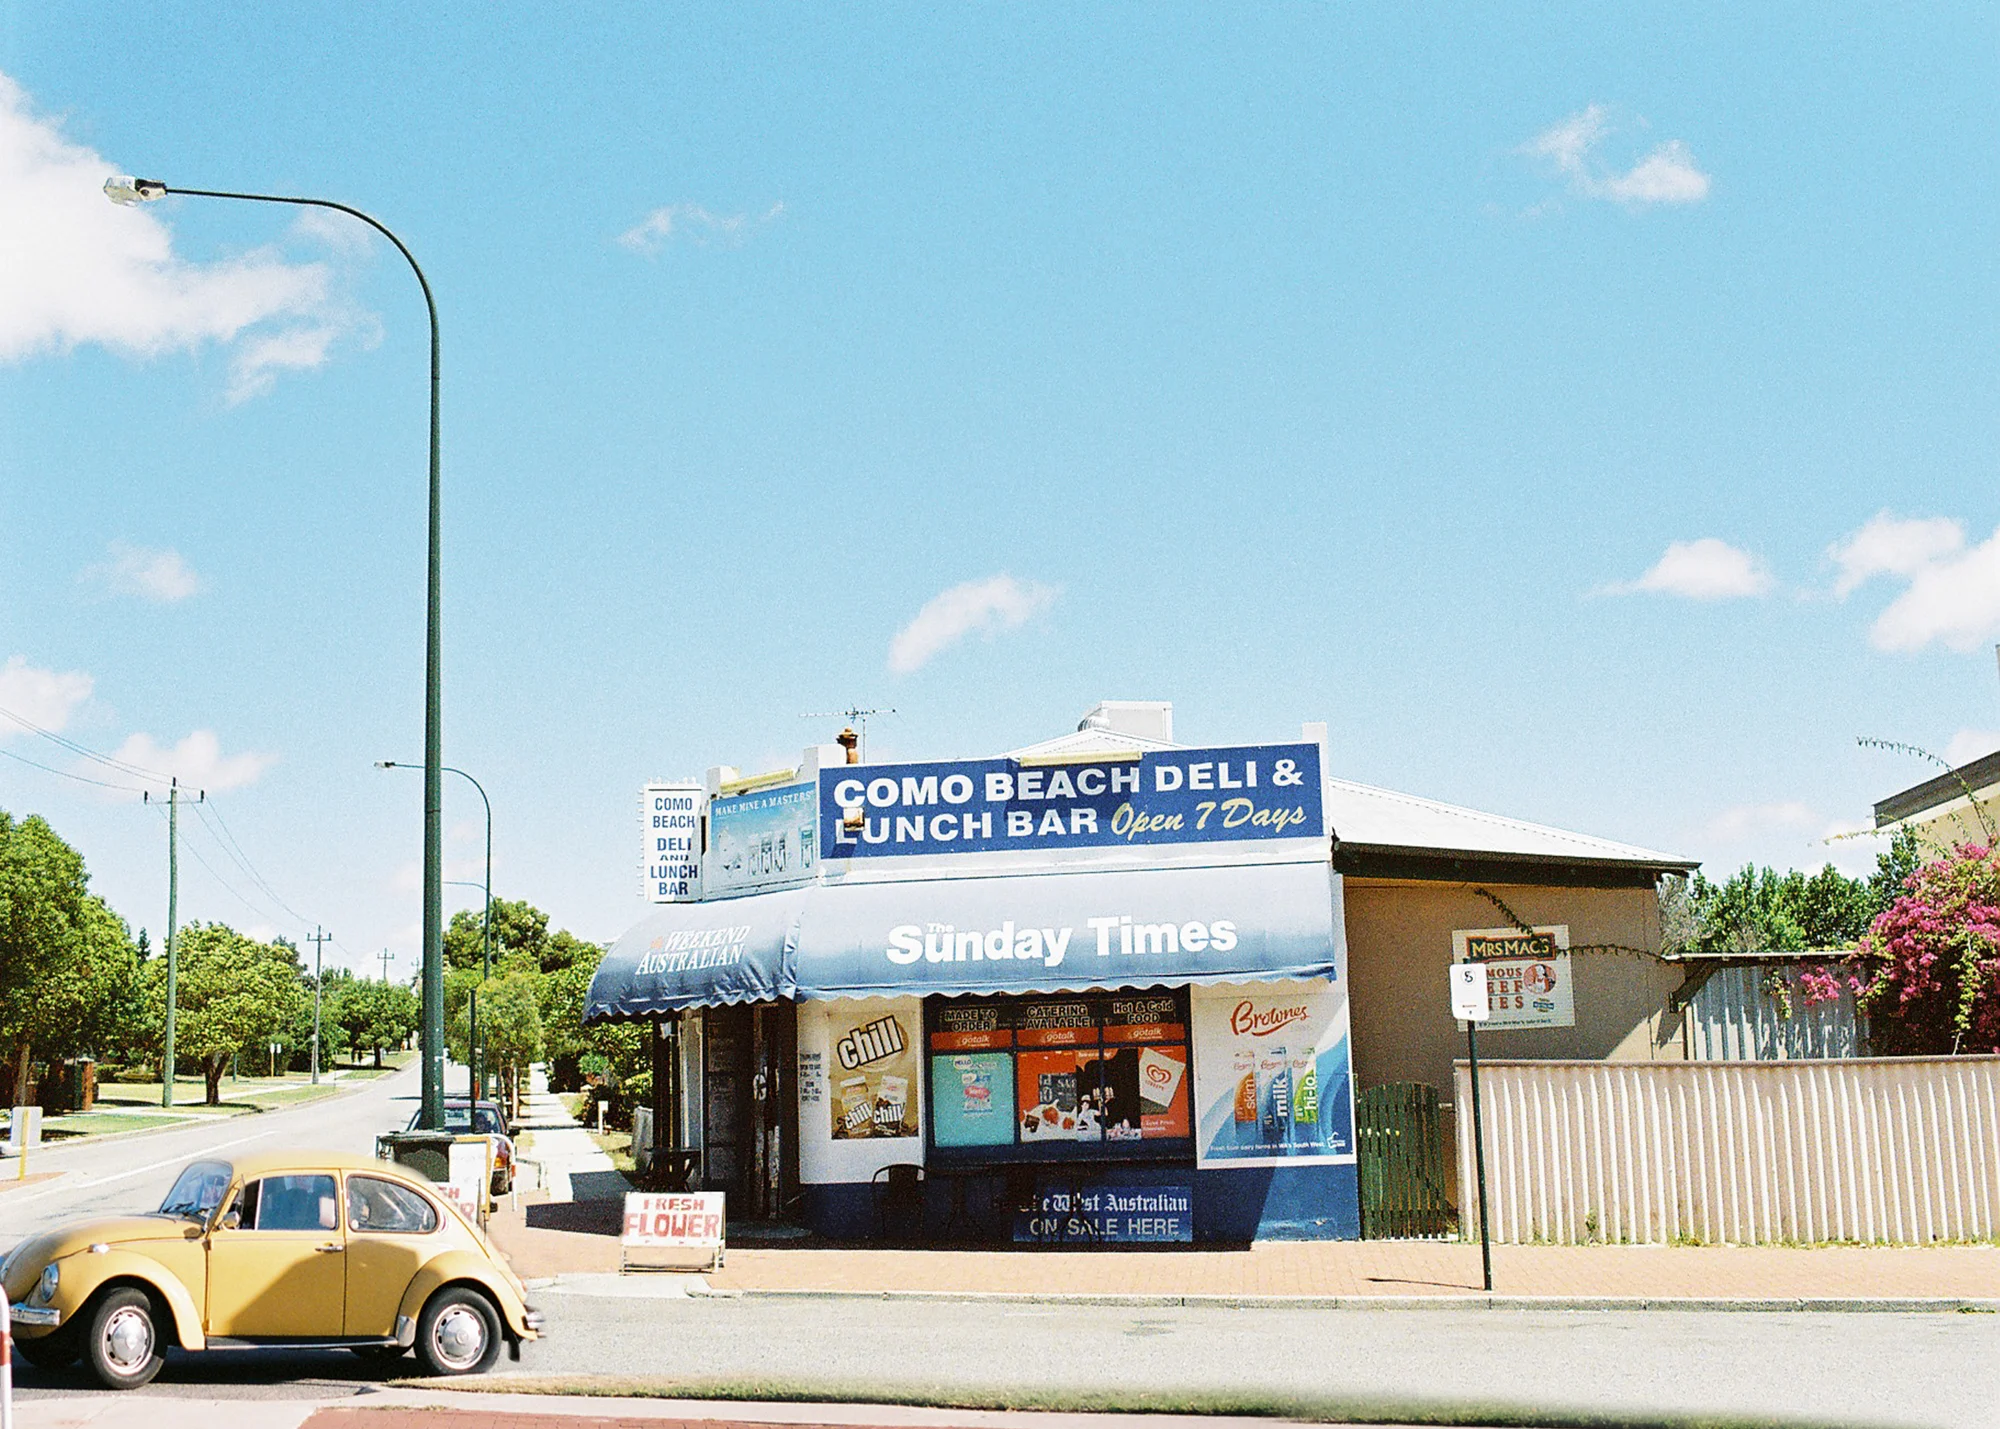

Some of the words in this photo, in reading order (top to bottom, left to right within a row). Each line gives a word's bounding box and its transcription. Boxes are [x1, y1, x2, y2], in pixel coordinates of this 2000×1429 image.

[833, 774, 974, 808] COMO
[984, 766, 1140, 802] BEACH
[1155, 760, 1258, 793] DELI
[1272, 758, 1304, 787] &
[655, 797, 693, 811] COMO
[715, 804, 737, 817] MAKE
[739, 800, 760, 813] MINE
[761, 799, 768, 809] A
[652, 815, 696, 829] BEACH
[835, 811, 993, 845] LUNCH
[1007, 807, 1099, 838] BAR
[1110, 802, 1185, 842] Open
[1196, 801, 1217, 830] 7
[1220, 797, 1308, 834] Days
[656, 837, 692, 852] DELI
[649, 864, 699, 879] LUNCH
[658, 881, 689, 895] BAR
[926, 922, 954, 934] The
[664, 925, 751, 951] WEEKEND
[886, 920, 1073, 967] Sunday
[1087, 917, 1238, 956] Times
[634, 943, 745, 975] AUSTRALIAN
[1486, 980, 1524, 993] EEF
[944, 1009, 979, 1021] MADE
[980, 1008, 998, 1019] TO
[1026, 1004, 1089, 1018] CATERING
[1113, 1001, 1133, 1014] Hot
[1136, 1000, 1146, 1013] &
[1147, 1000, 1174, 1012] Cold
[952, 1020, 993, 1033] ORDER
[1025, 1016, 1091, 1029] AVAILABLE
[1127, 1012, 1161, 1025] FOOD
[1230, 1001, 1310, 1036] Brownes
[837, 1014, 904, 1070] chill
[1243, 1079, 1256, 1110] skim
[1272, 1077, 1288, 1117] milk
[1303, 1076, 1318, 1111] hi-lo
[844, 1102, 873, 1129] chill
[873, 1103, 905, 1124] chill
[1104, 1193, 1188, 1211] Australian
[623, 1213, 720, 1238] FLOWER
[1128, 1218, 1179, 1235] HERE
